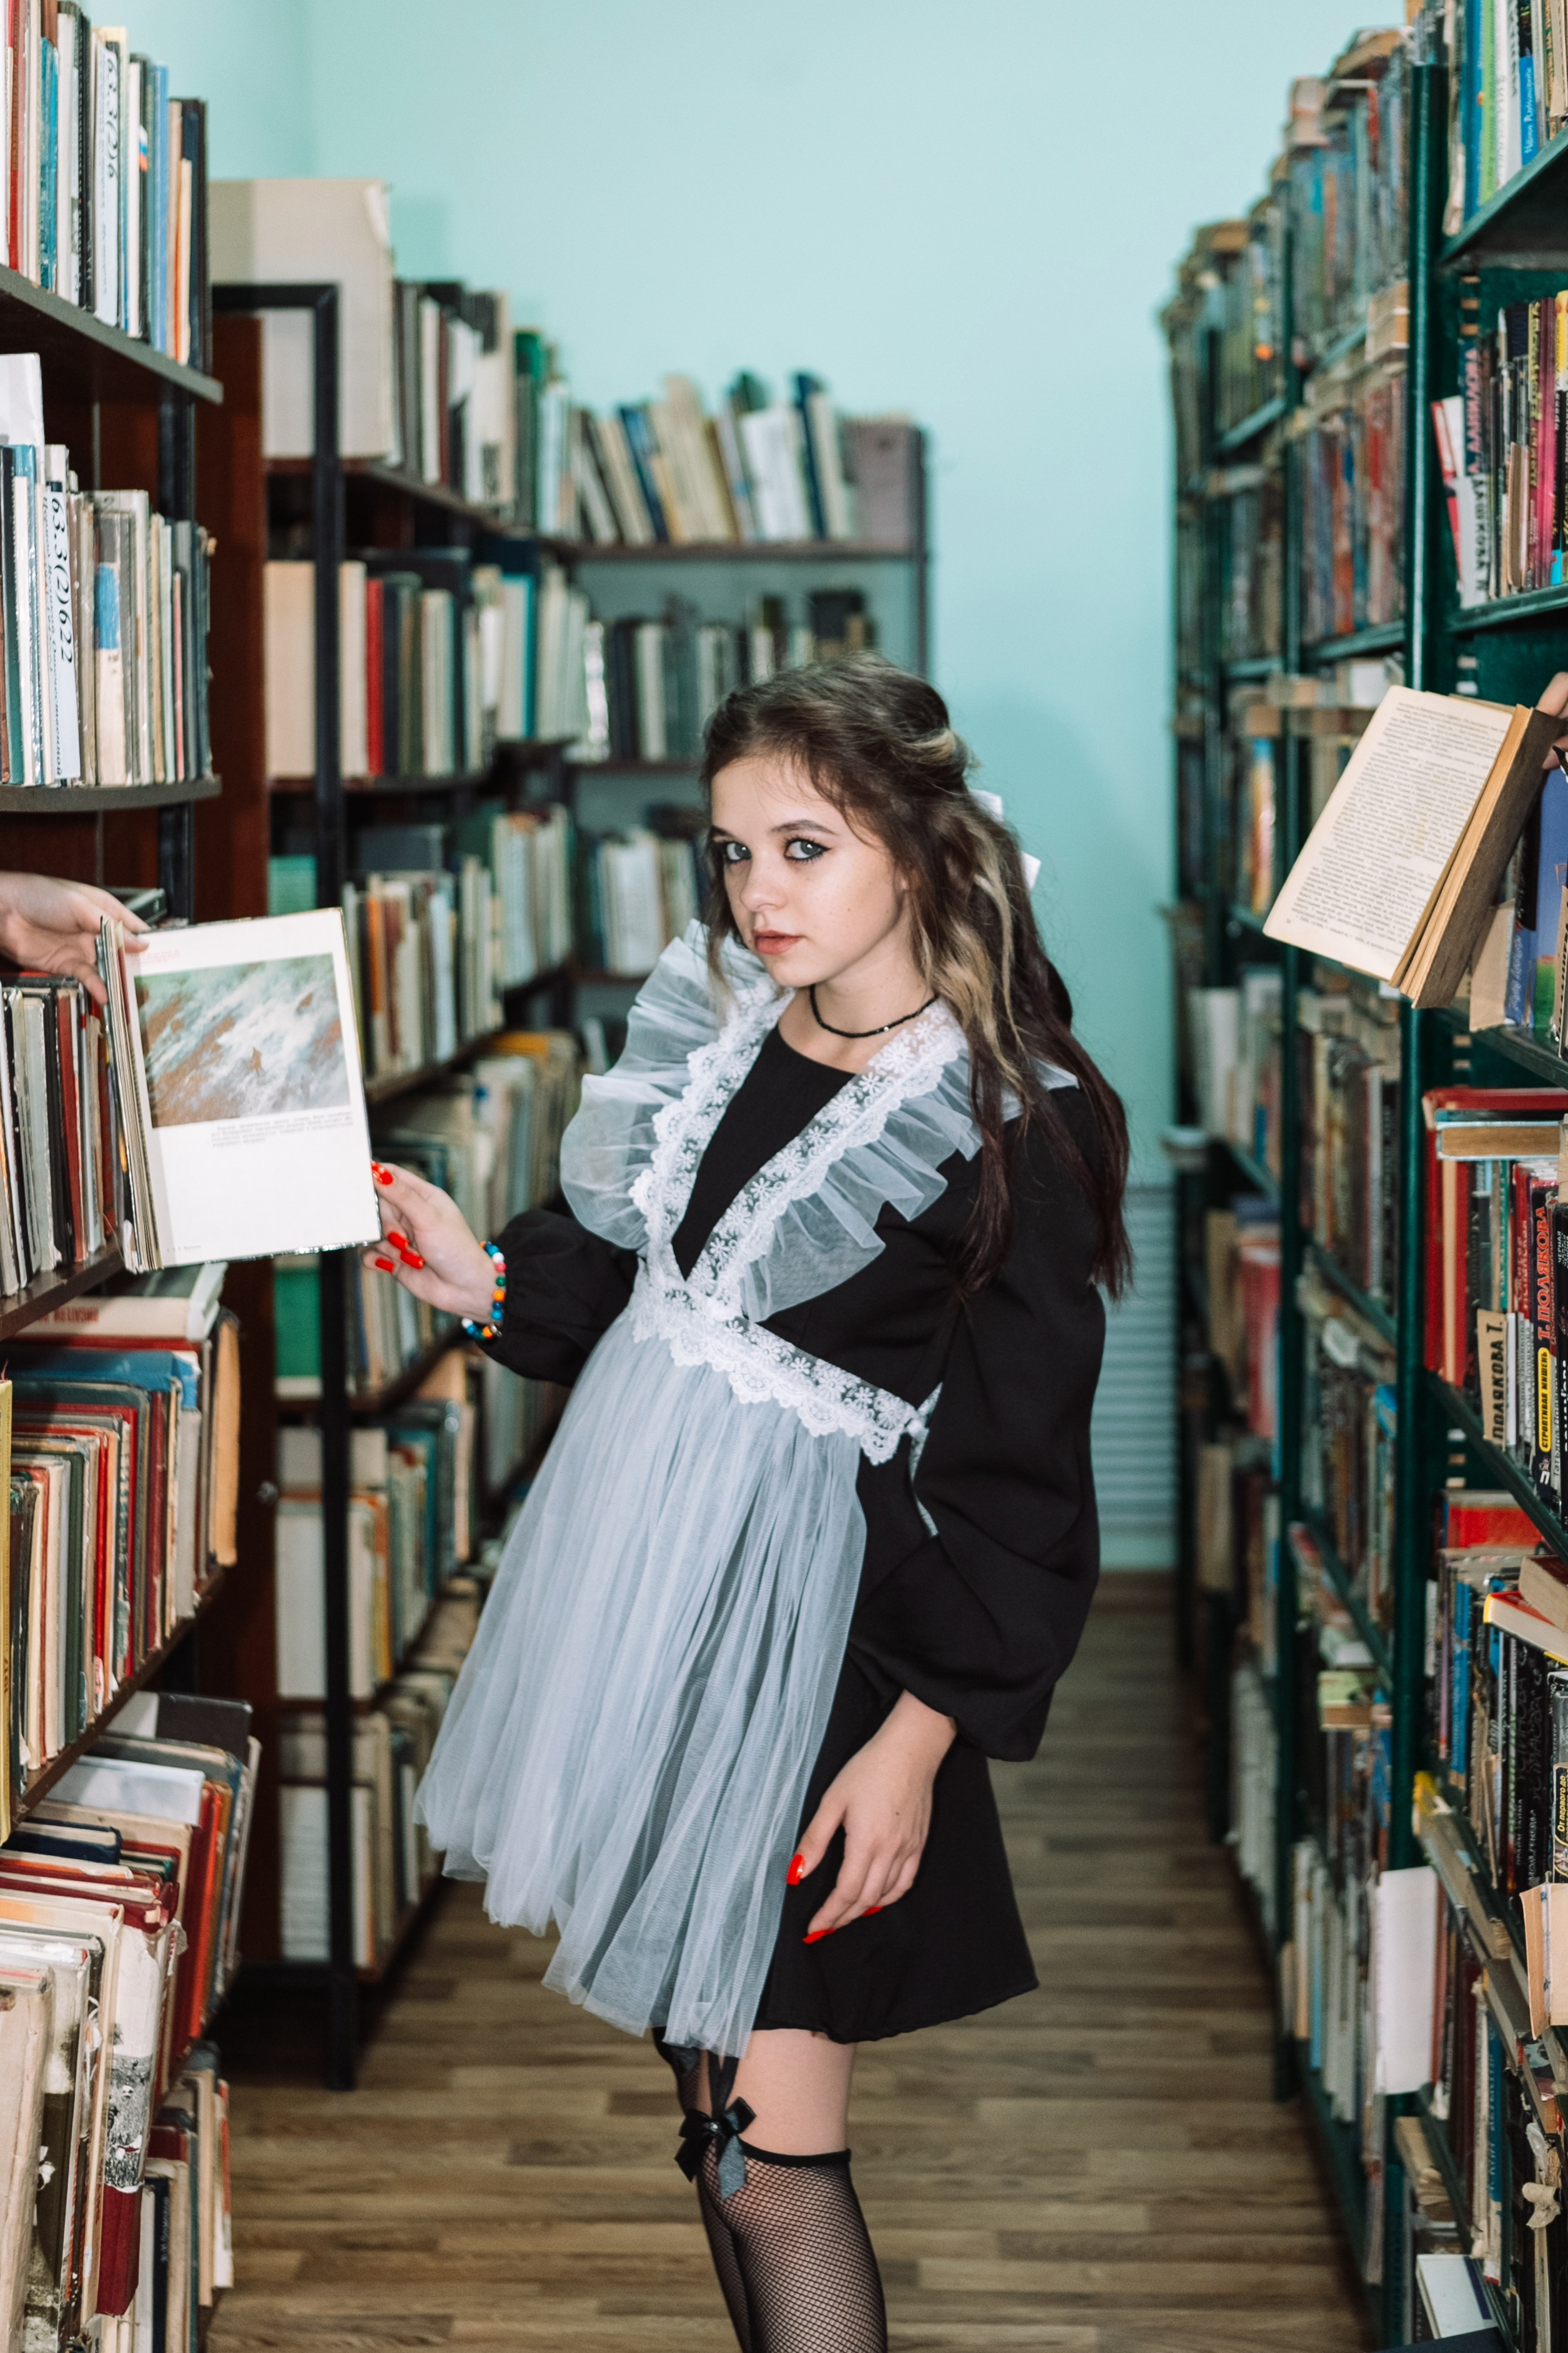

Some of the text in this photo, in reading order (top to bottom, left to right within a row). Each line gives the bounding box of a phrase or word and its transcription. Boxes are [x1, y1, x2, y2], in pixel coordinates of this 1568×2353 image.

[52, 497, 73, 665] 63.3(2)622
[42, 496, 62, 776] Период Великой Отечественной
[1536, 1206, 1551, 1340] Т. ПОЛЯКОВА
[1486, 1321, 1502, 1332] Т.
[1490, 1340, 1504, 1440] ПОЛЯКОВА
[1517, 1677, 1527, 1780] УСТИНОВА
[1528, 1696, 1542, 1801] УСТИНОВА
[1557, 1821, 1565, 1832] От
[1560, 1775, 1567, 1787] до
